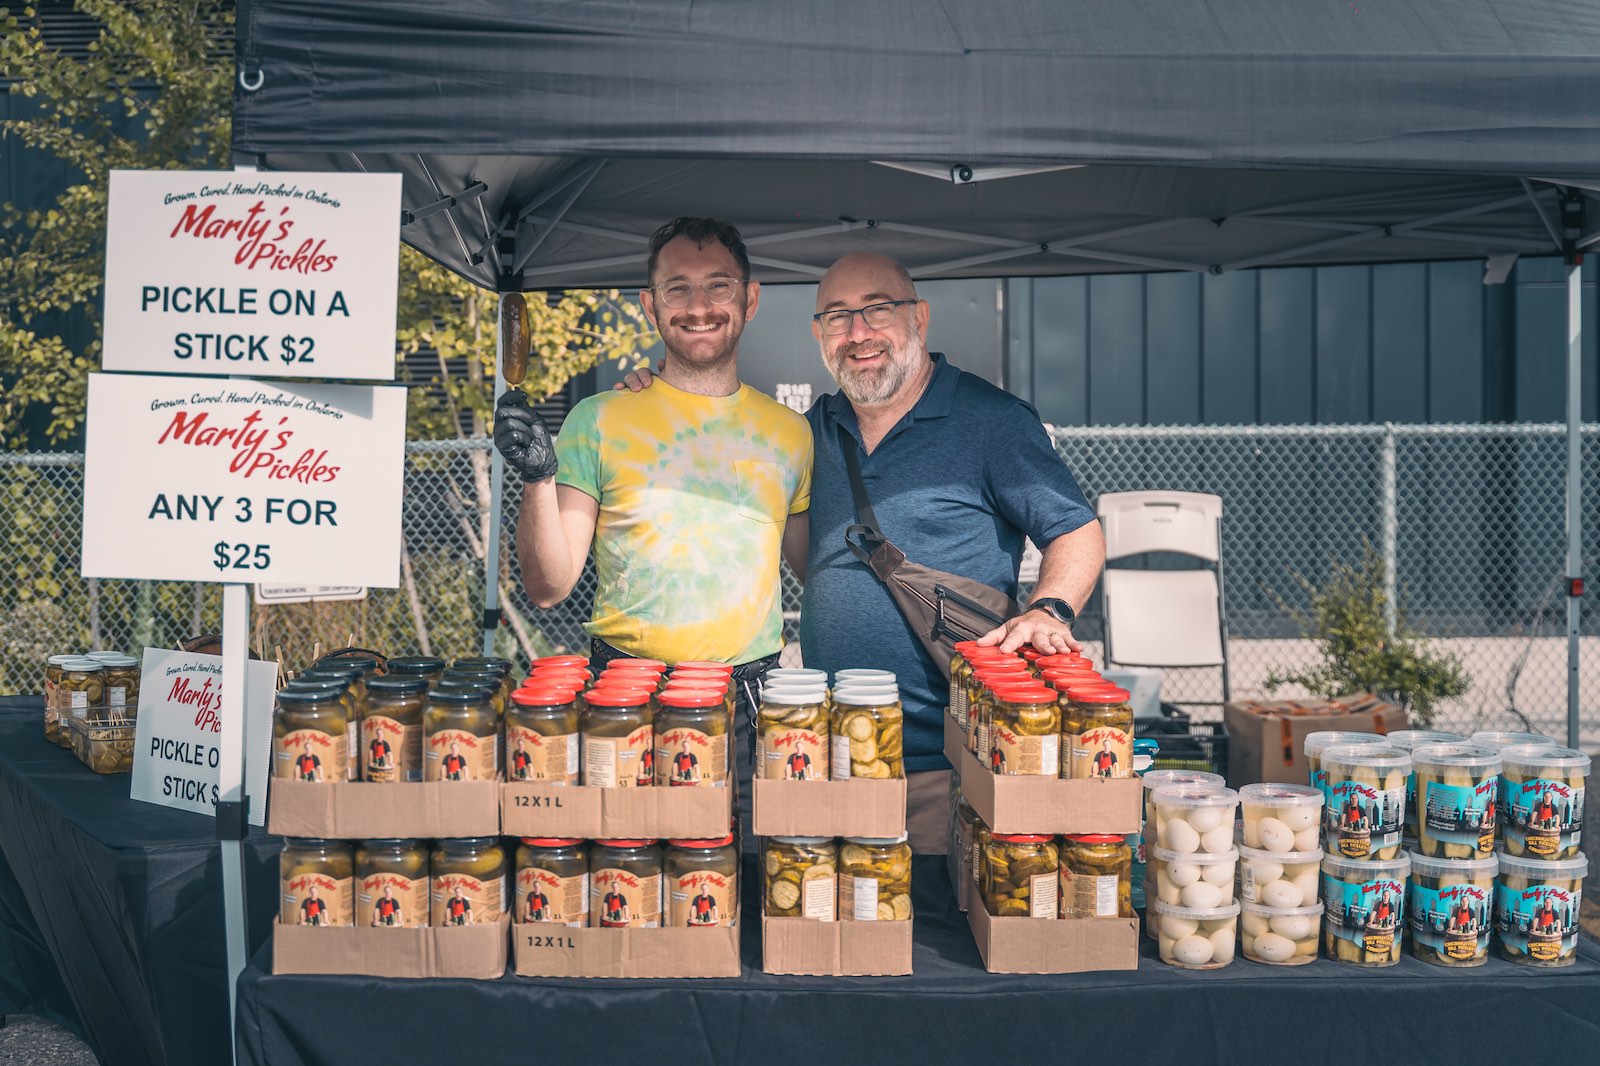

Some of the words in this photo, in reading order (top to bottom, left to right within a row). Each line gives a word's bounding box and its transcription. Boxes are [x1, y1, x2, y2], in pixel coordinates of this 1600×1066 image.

[232, 182, 261, 195] Hand
[258, 183, 296, 198] Packed
[293, 188, 303, 199] in
[305, 190, 341, 208] Ontario
[170, 201, 294, 265] Marty's
[248, 238, 338, 275] Pickles
[141, 286, 257, 316] PICKLE
[269, 289, 316, 317] ON
[326, 290, 350, 317] A
[173, 333, 270, 362] STICK
[280, 335, 315, 365] $2
[225, 391, 258, 404] Hand
[255, 393, 297, 407] Packed
[293, 400, 303, 409] in
[305, 400, 344, 420] Ontario
[158, 409, 294, 473] Marty's
[244, 448, 340, 485] Pickles
[148, 493, 224, 521] ANY
[235, 497, 253, 522] 3
[265, 498, 338, 526] FOR
[213, 540, 271, 571] $25
[167, 676, 222, 726] Marty's
[200, 710, 222, 733] Pic
[151, 737, 203, 766] PICKLE
[208, 747, 220, 768] O
[163, 775, 207, 803] STICK
